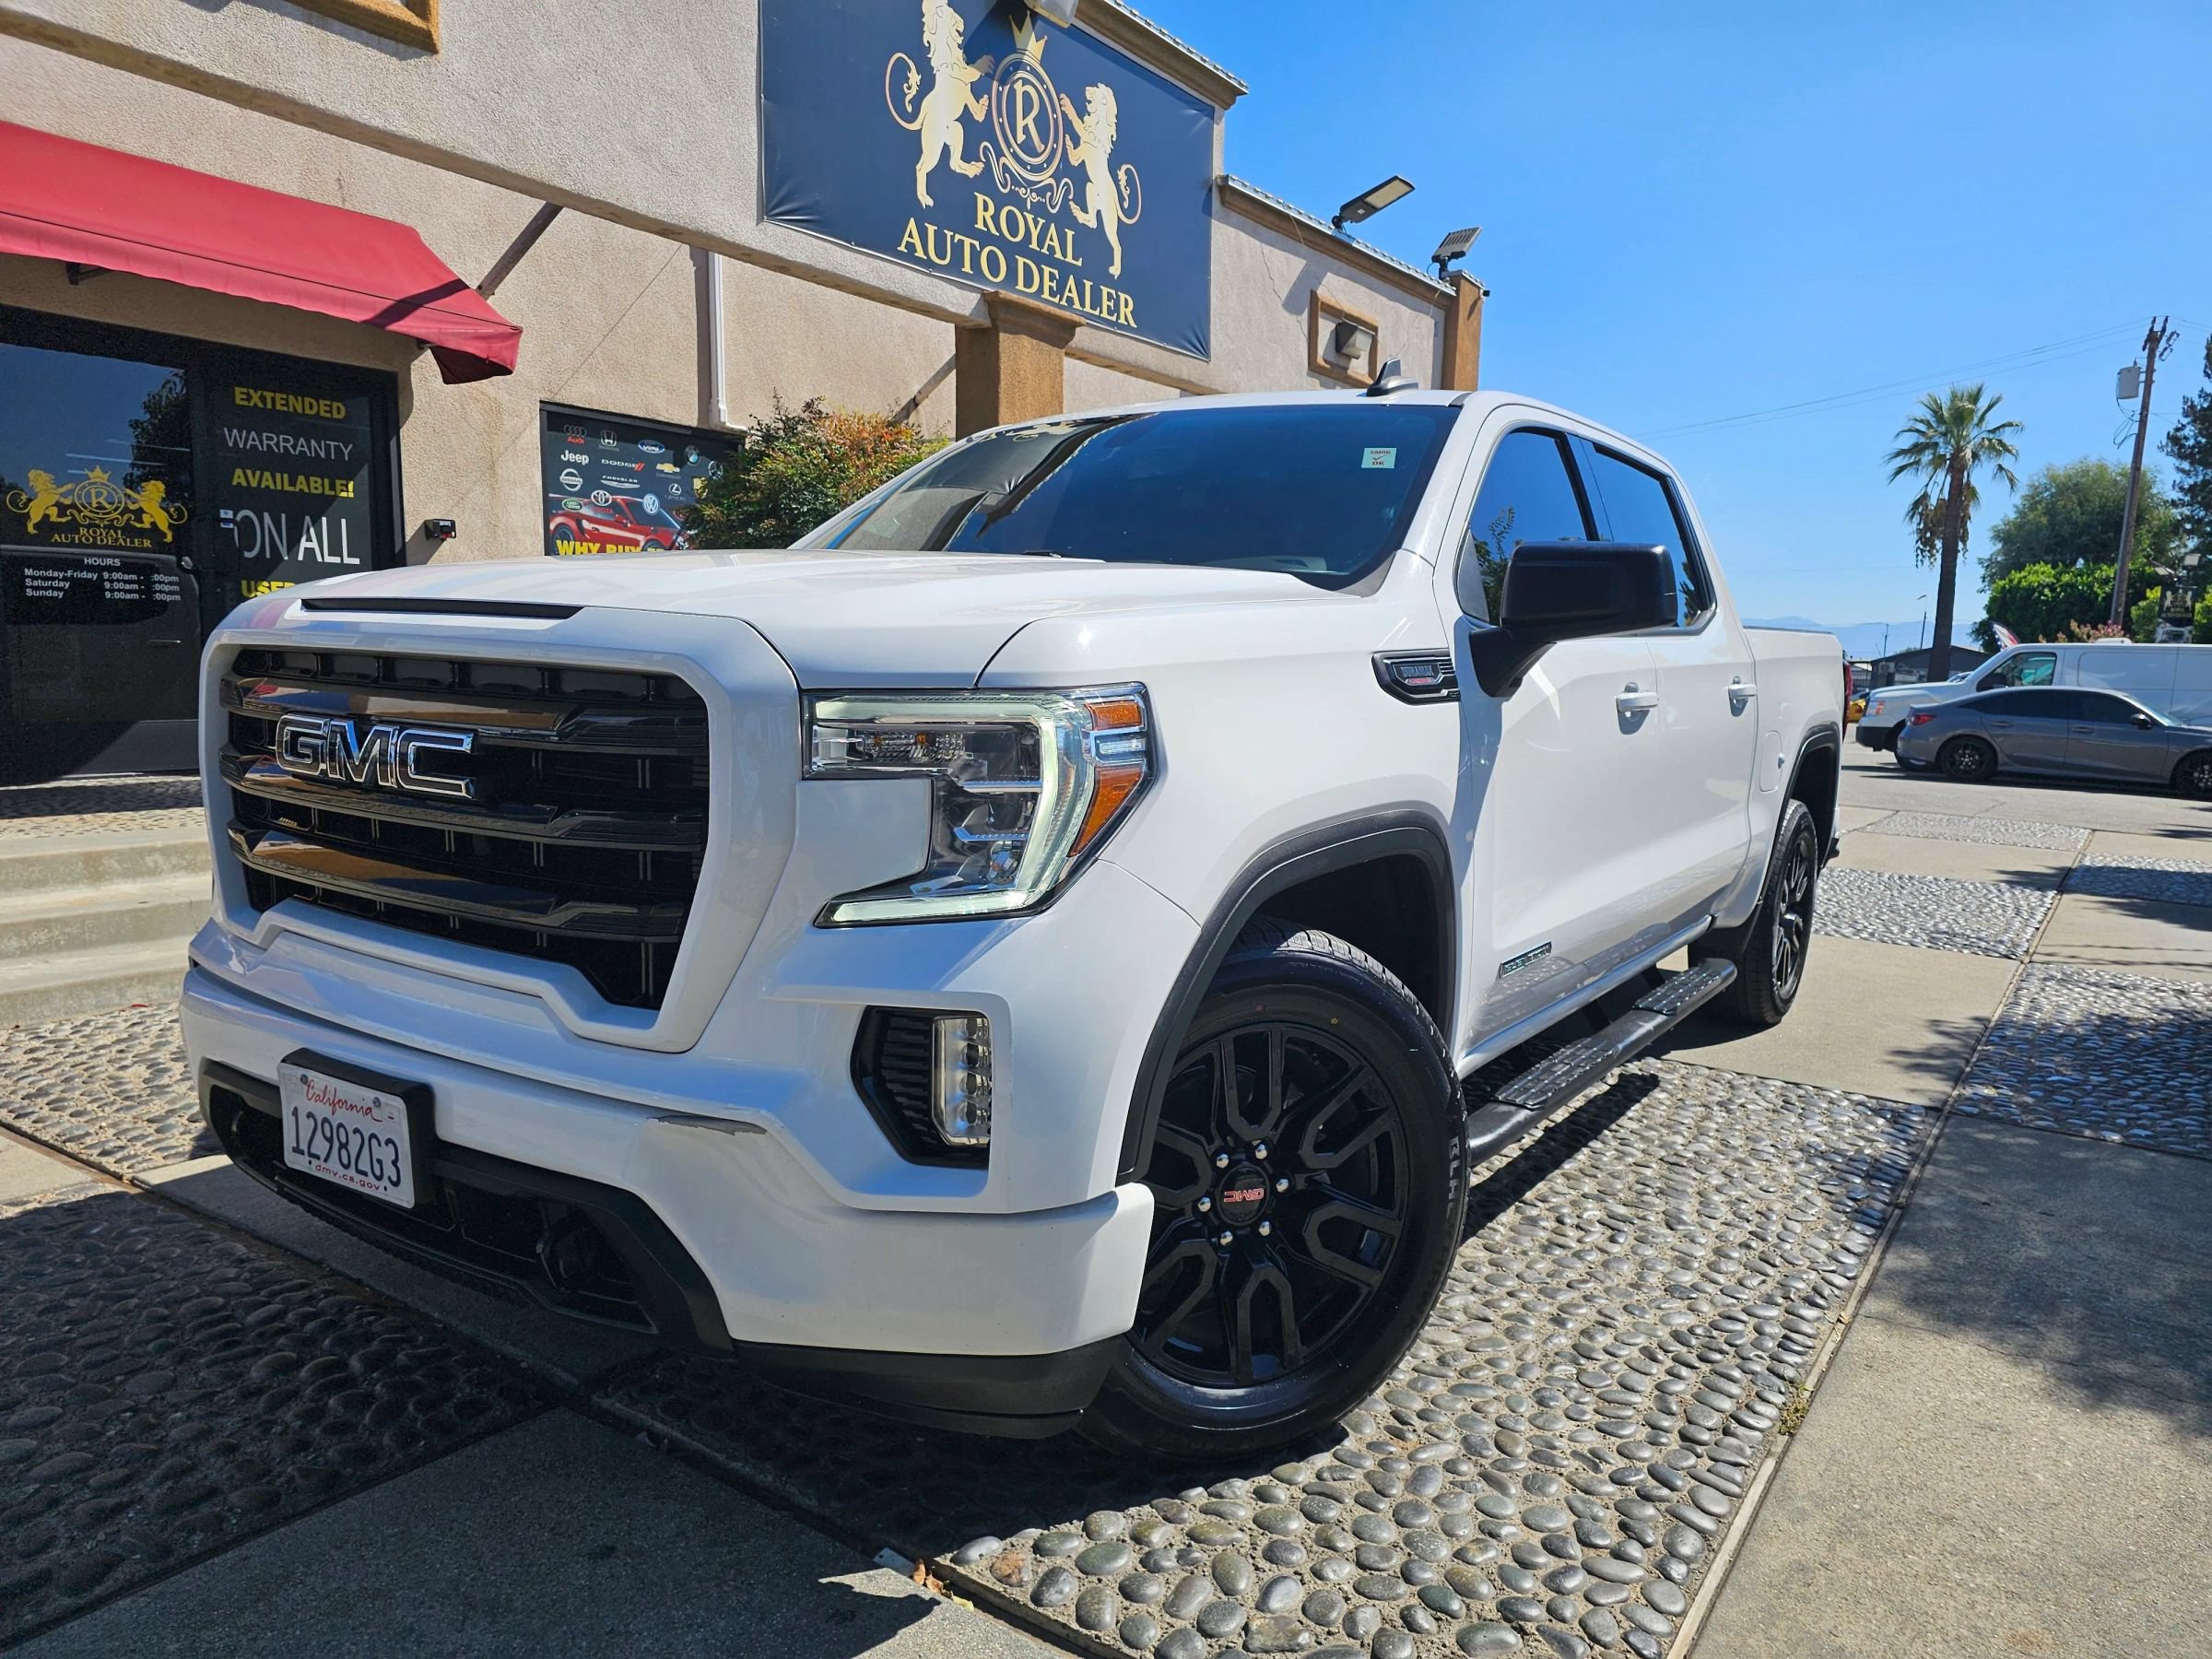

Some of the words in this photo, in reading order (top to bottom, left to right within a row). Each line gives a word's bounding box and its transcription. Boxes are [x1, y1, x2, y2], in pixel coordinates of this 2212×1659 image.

[973, 192, 1083, 267] ROYAL
[897, 217, 1007, 284] AUTO
[1015, 254, 1138, 328] DEALER
[233, 385, 347, 419] EXTENDED
[223, 427, 354, 461] WARRANTY
[568, 436, 585, 444] Audi
[560, 450, 590, 465] Jeep
[231, 467, 355, 498] AVAILABLE!
[52, 534, 93, 544] AUTO
[97, 536, 152, 547] DEALER
[79, 526, 126, 538] ROYAL
[233, 509, 288, 560] ON
[297, 515, 360, 564] ALL
[556, 539, 601, 555] WHY
[84, 557, 121, 566] HOURS
[24, 568, 99, 581] Monday-Friday
[102, 571, 138, 581] 9:00am
[25, 578, 70, 589] Saturday
[104, 582, 139, 590] 9:00am
[26, 588, 65, 598] Sunday
[105, 591, 139, 599] 9:00am
[276, 712, 475, 799] GMC
[305, 1079, 383, 1122] California
[291, 1105, 402, 1187] 12982G3
[315, 1164, 381, 1191] dmv.ca.gov
[1223, 1187, 1264, 1203] GMC
